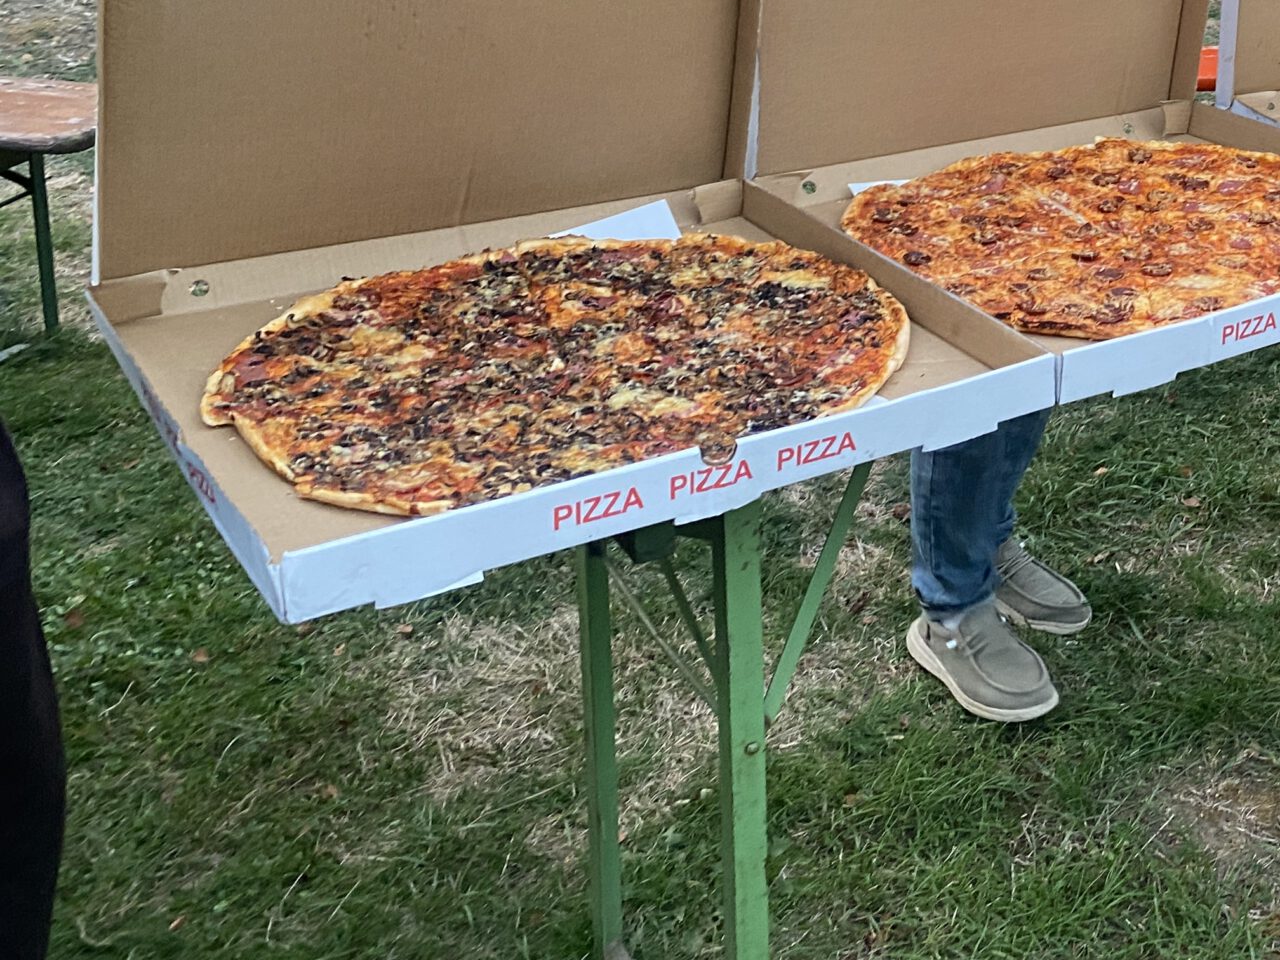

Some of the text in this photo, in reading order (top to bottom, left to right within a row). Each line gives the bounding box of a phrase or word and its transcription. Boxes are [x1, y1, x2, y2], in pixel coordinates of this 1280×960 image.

[1222, 312, 1277, 345] PIZZA
[553, 431, 857, 531] PIZZA PIZZA PIZZA
